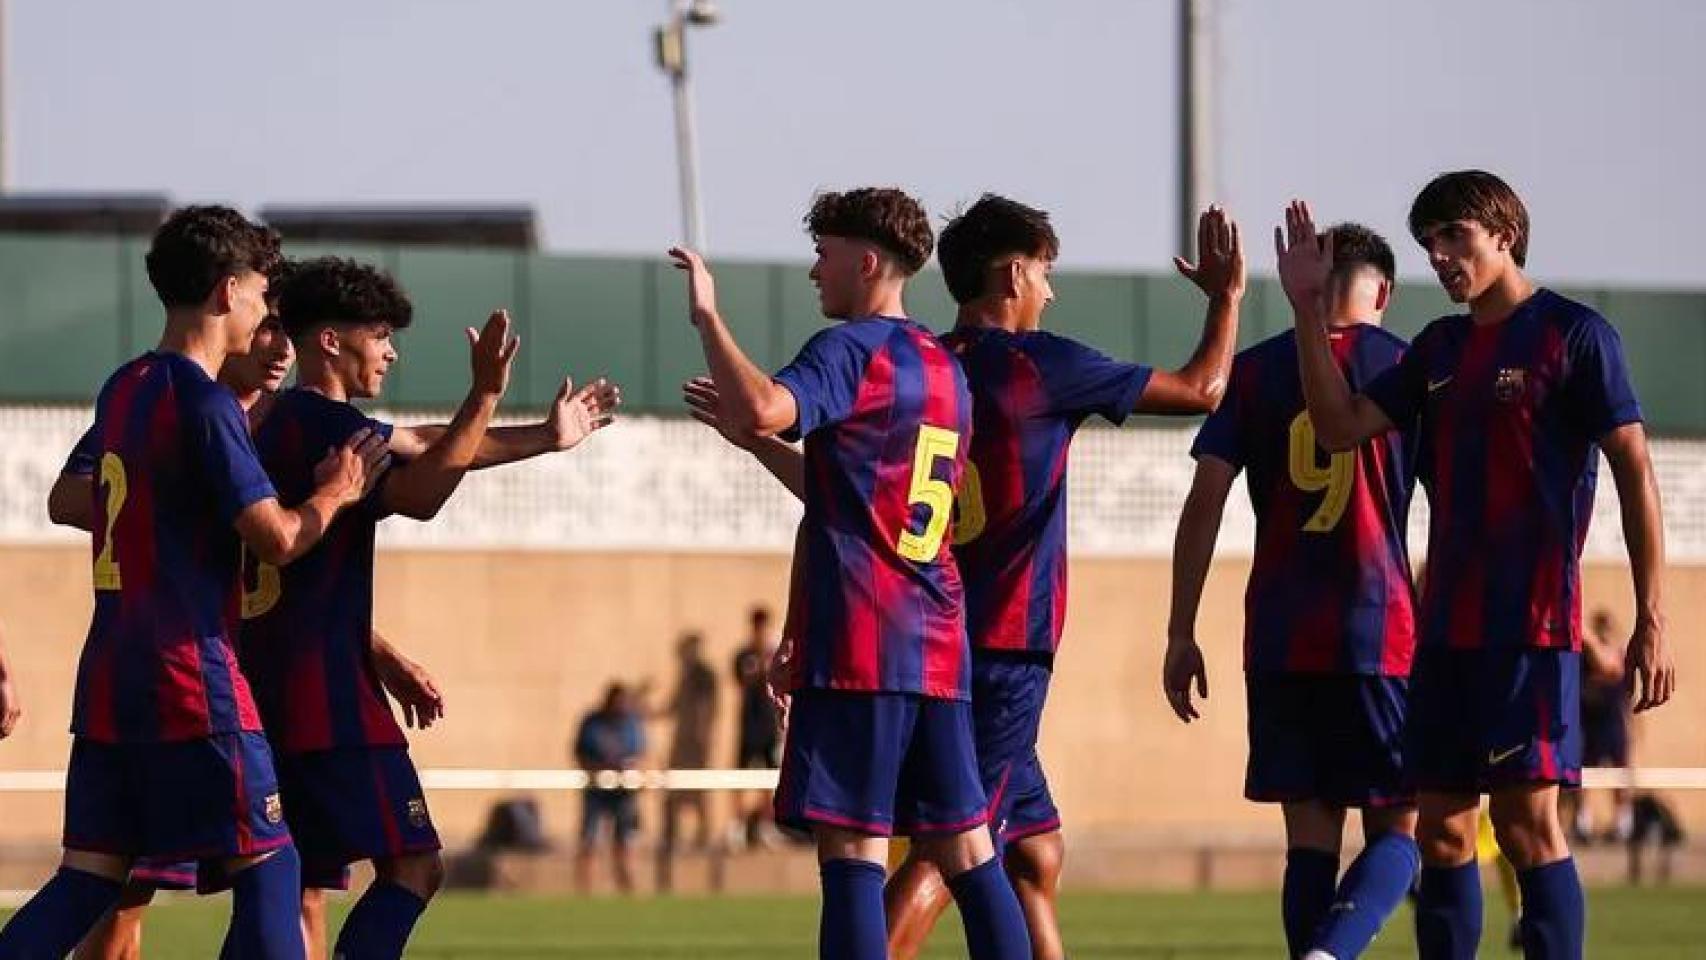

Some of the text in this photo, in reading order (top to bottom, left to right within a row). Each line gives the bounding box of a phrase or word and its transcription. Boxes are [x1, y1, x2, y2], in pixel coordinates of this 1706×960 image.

[94, 452, 127, 590] 2
[897, 424, 960, 563] 5
[1289, 408, 1354, 531] 9
